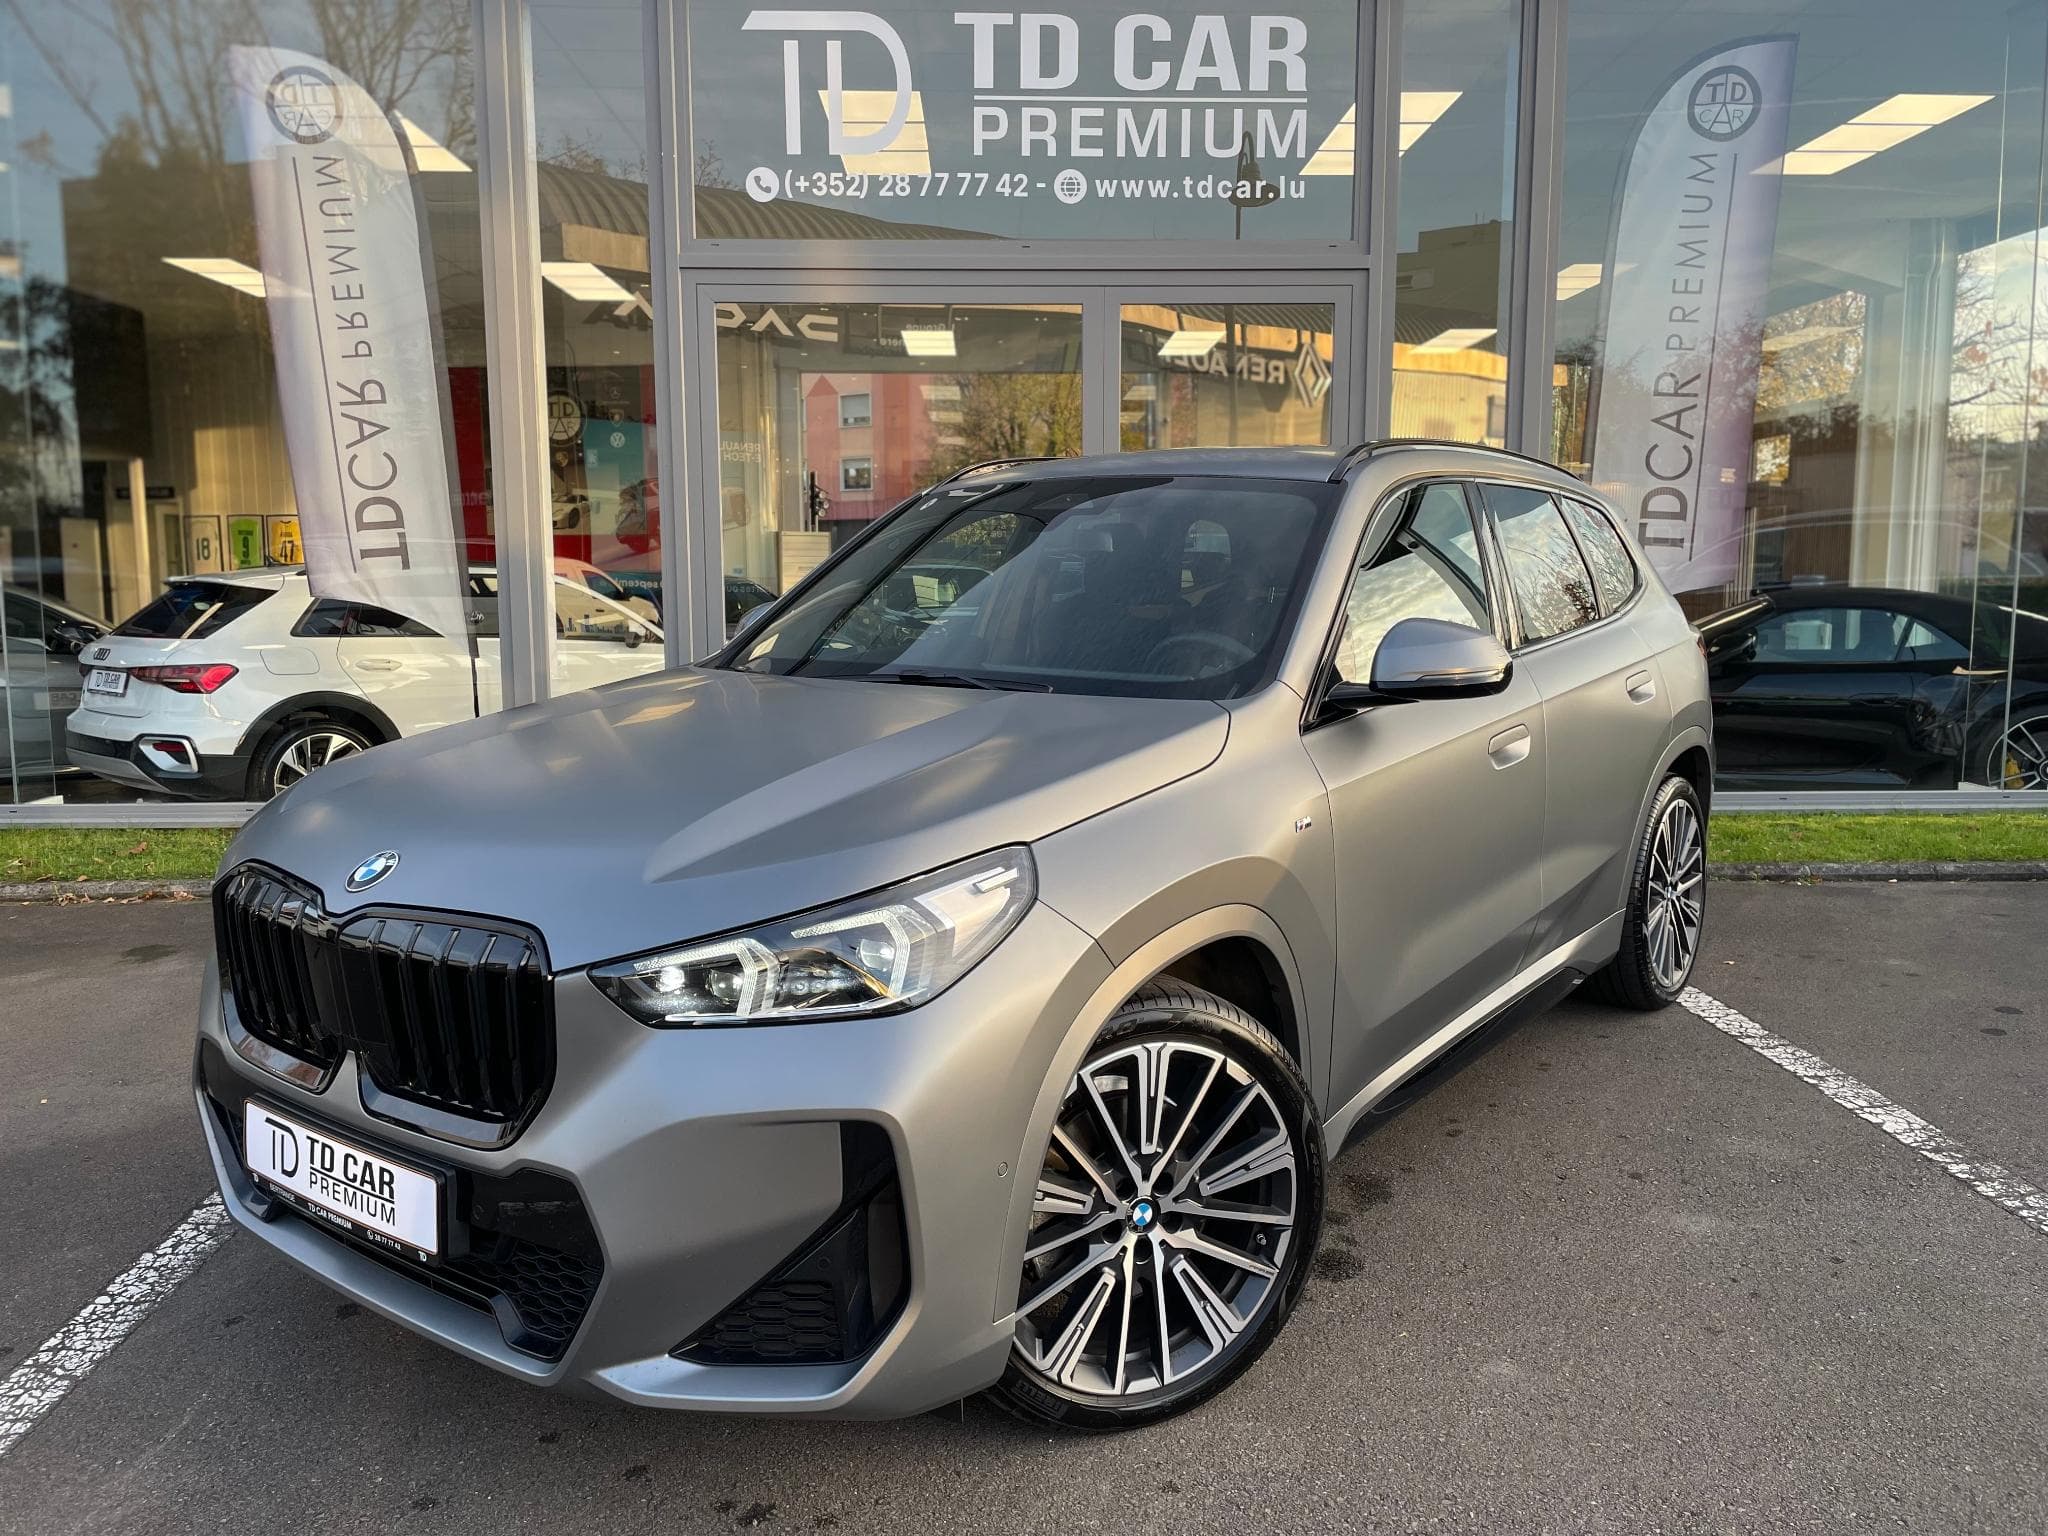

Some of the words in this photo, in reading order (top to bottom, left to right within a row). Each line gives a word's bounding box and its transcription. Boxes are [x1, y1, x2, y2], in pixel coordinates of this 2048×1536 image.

[954, 12, 1079, 89] TD
[1114, 14, 1308, 91] CAR
[1705, 81, 1748, 103] TD
[973, 106, 1308, 159] PREMIUM
[784, 170, 869, 199] (+352)
[878, 173, 911, 197] 28
[918, 172, 949, 197] 77
[956, 173, 989, 197] 77
[995, 173, 1029, 197] 42
[1095, 174, 1306, 199] www.tdcar.lu
[1665, 153, 1718, 351] PREMIUM
[196, 537, 211, 561] 18
[279, 540, 295, 562] 47
[306, 1135, 335, 1173] TD
[343, 1153, 395, 1200] CAR
[309, 1171, 395, 1226] PREMIUM
